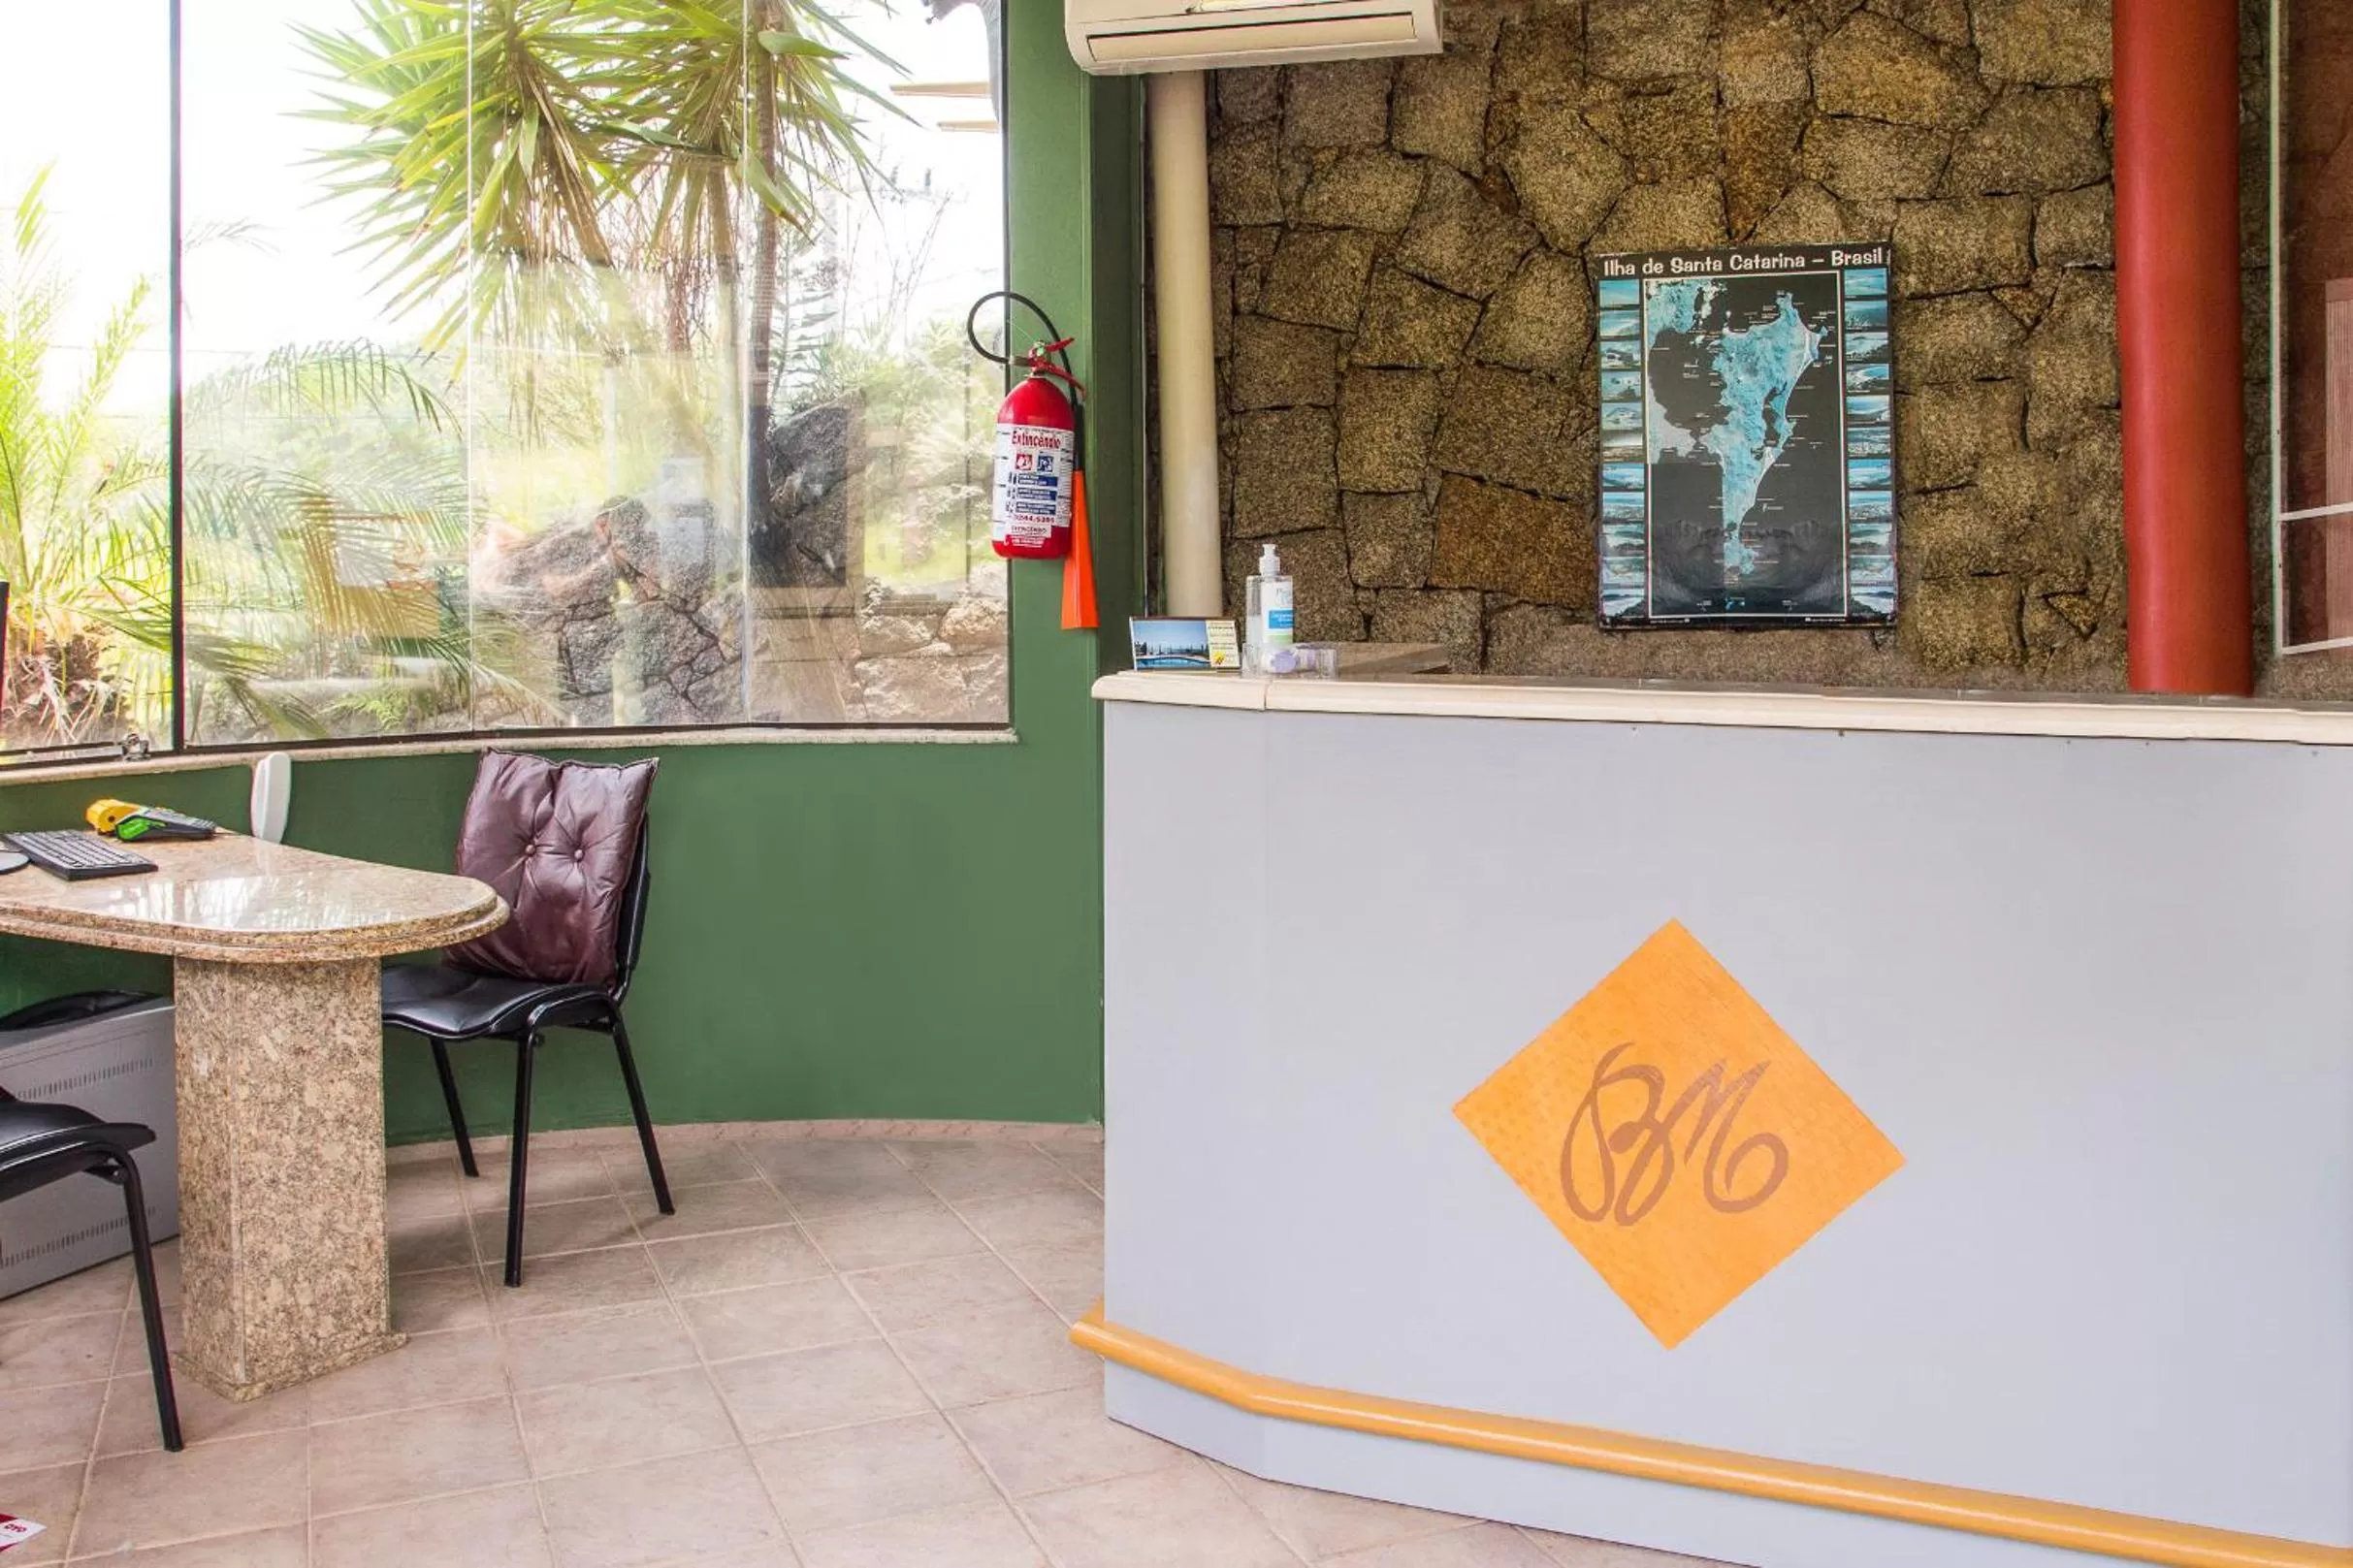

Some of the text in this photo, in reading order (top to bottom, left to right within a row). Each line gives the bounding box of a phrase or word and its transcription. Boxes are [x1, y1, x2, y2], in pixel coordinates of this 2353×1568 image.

[1603, 259, 1636, 277] Ilha
[1642, 257, 1664, 274] de
[1670, 256, 1724, 273] Santa
[1729, 252, 1806, 272] Catarina
[1830, 247, 1883, 267] Brasil
